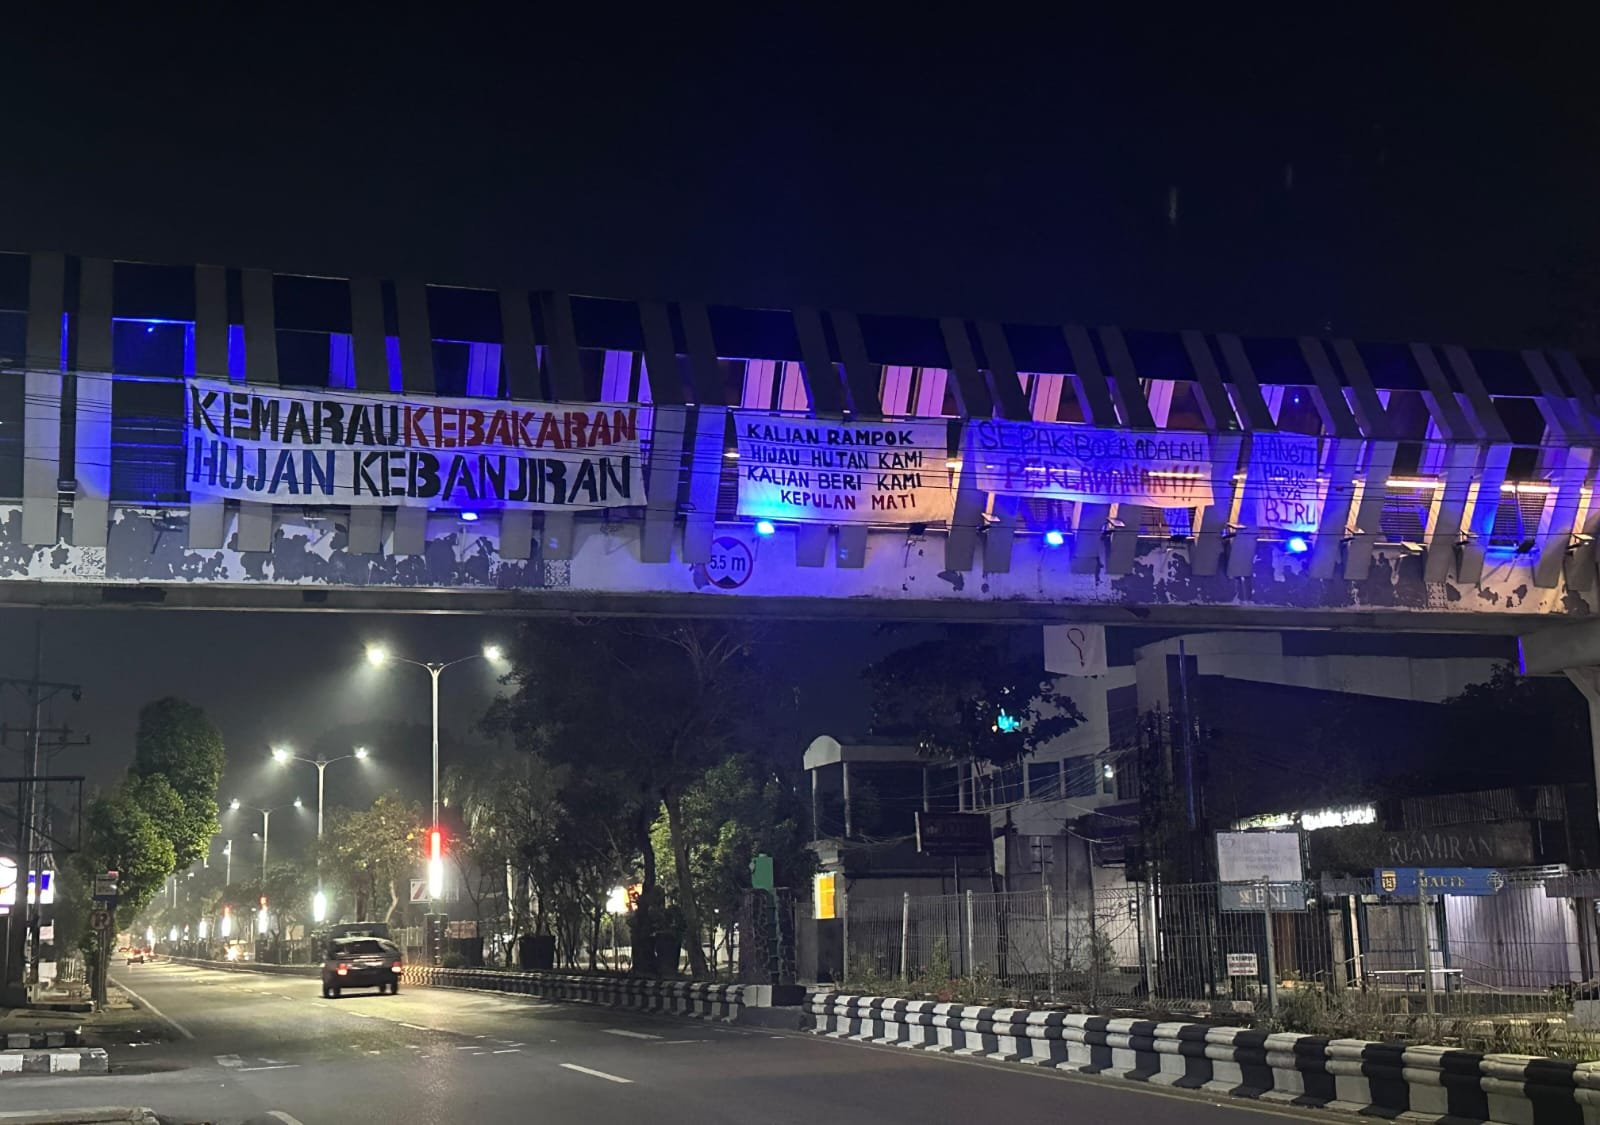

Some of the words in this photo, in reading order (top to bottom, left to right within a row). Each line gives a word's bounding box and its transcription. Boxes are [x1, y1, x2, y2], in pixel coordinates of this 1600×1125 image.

[190, 384, 398, 445] KEMARAU
[403, 404, 636, 450] KEBAKARAN
[748, 423, 820, 446] KALIAN
[827, 430, 914, 446] RAMPOK
[977, 421, 1073, 459] SEPAK
[1135, 439, 1202, 461] ADALAH
[193, 436, 335, 496] HUJAN
[353, 450, 631, 504] KEBANJIRAN
[751, 444, 799, 467] HIJAU
[811, 451, 869, 470] HUTAN
[879, 451, 922, 469] KAMI
[747, 465, 810, 488] KALIAN
[818, 473, 862, 490] BERI
[877, 473, 921, 491] KAMI
[781, 489, 856, 510] KEPULAN
[872, 493, 916, 510] MATI
[1265, 499, 1316, 525] BIRU
[710, 554, 727, 571] 5.5
[1255, 887, 1287, 904] BNI
